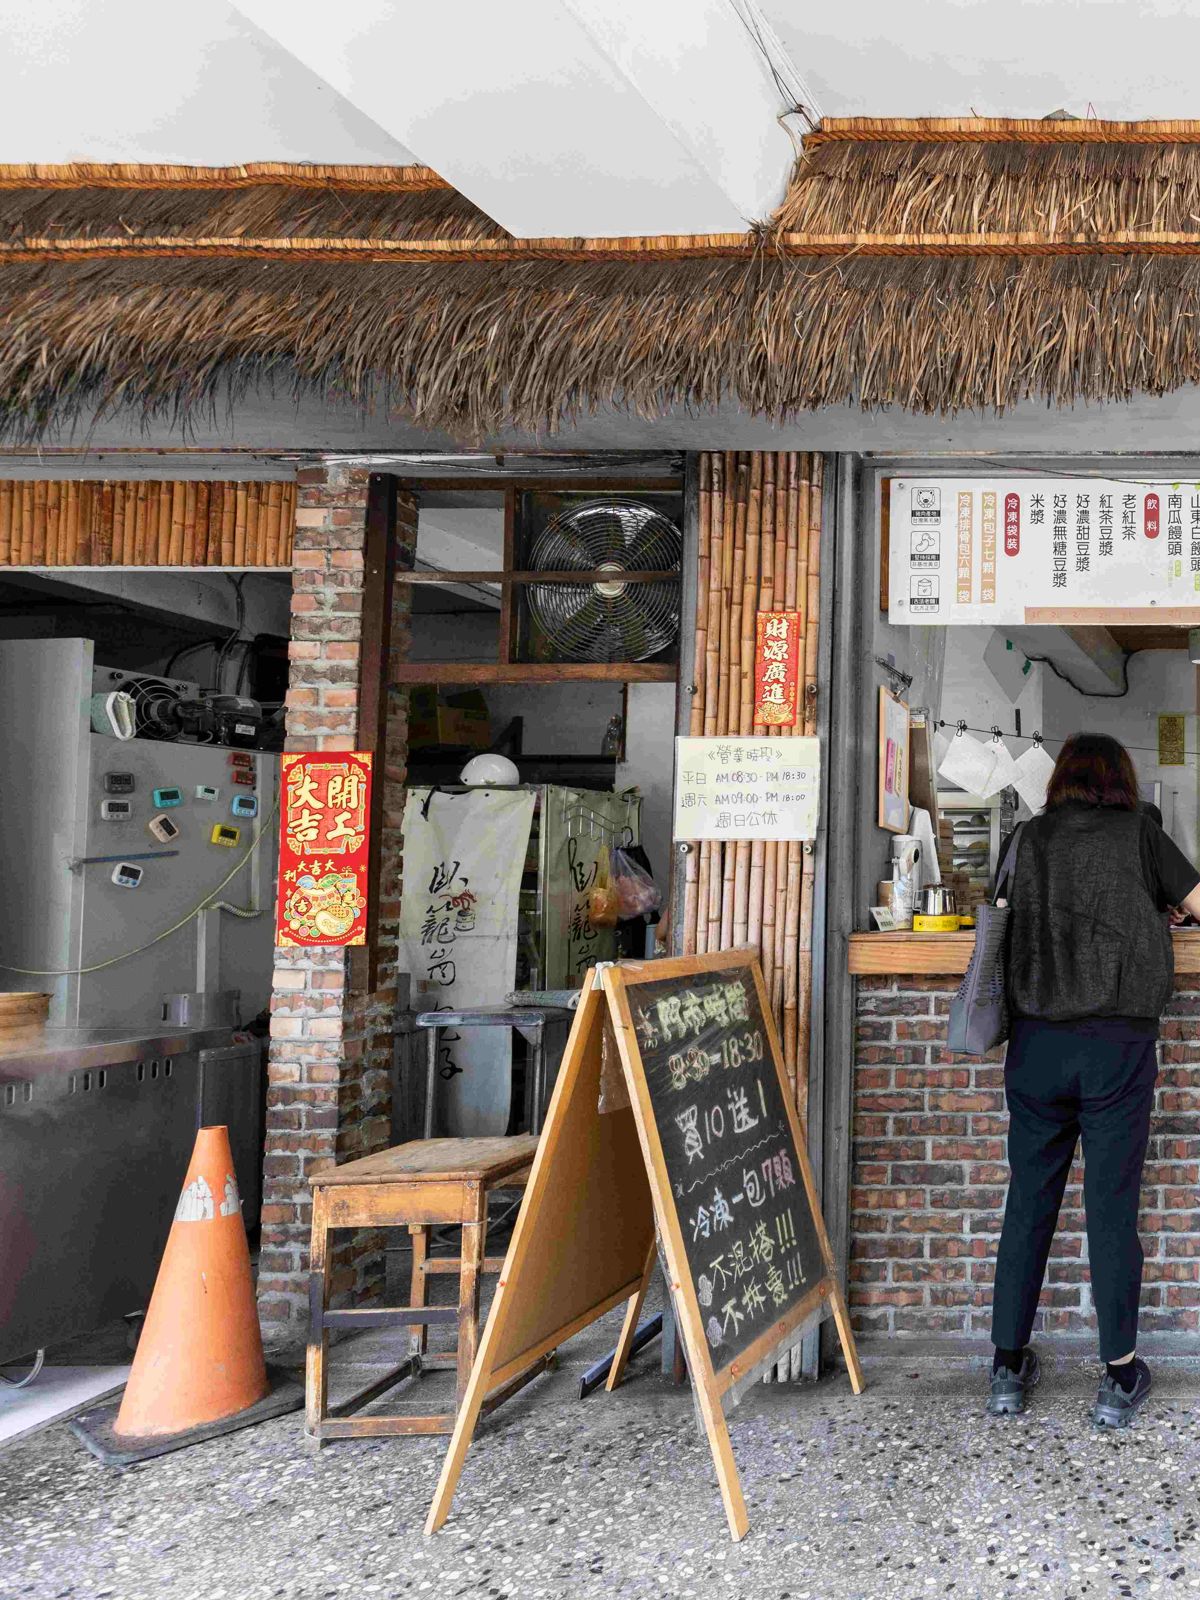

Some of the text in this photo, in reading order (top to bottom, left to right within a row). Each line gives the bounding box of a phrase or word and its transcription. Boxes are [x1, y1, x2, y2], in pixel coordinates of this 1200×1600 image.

[1006, 498, 1018, 550] 冷凍袋裝
[1030, 493, 1045, 525] 米漿
[1075, 493, 1091, 572] 好濃甜豆漿
[1098, 493, 1114, 557] 紅茶豆漿
[1121, 493, 1137, 541] 老紅茶
[1146, 498, 1158, 532] 飲料
[1167, 494, 1183, 556] 南瓜饅頭
[1052, 493, 1068, 588] 好濃無糖豆漿
[761, 618, 790, 705] 財源廣進
[290, 774, 326, 841] 大吉
[325, 774, 360, 841] 開工
[682, 770, 707, 785] 平日
[715, 811, 778, 829] 週日公休
